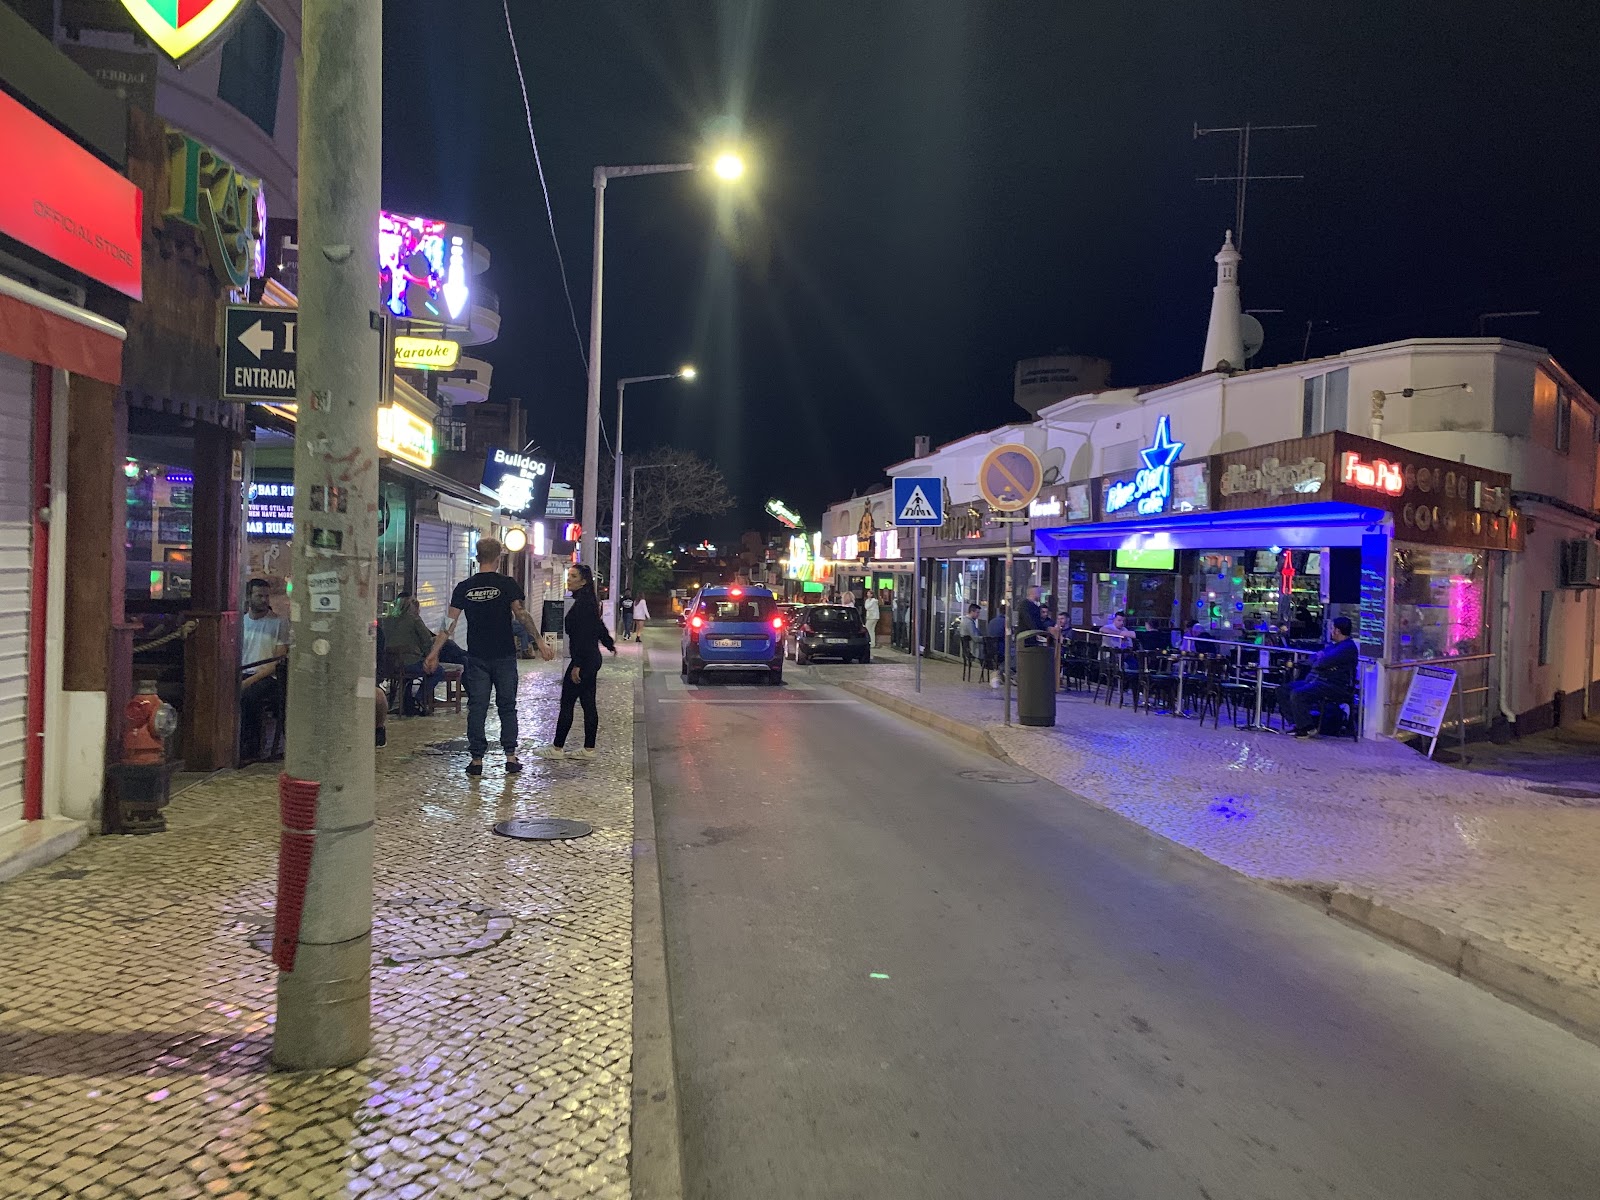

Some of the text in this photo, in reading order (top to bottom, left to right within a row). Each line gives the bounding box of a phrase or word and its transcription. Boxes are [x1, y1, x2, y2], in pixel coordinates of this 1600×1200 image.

[33, 199, 132, 269] OFFICIAL STORE
[395, 345, 449, 358] Karaoke
[234, 367, 296, 389] ENTRADA
[494, 449, 546, 476] Bulldog
[519, 468, 537, 480] Bar
[1346, 455, 1375, 486] Fun
[1376, 463, 1403, 493] Pub
[257, 484, 278, 496] BAR
[249, 504, 269, 512] YOU'RE
